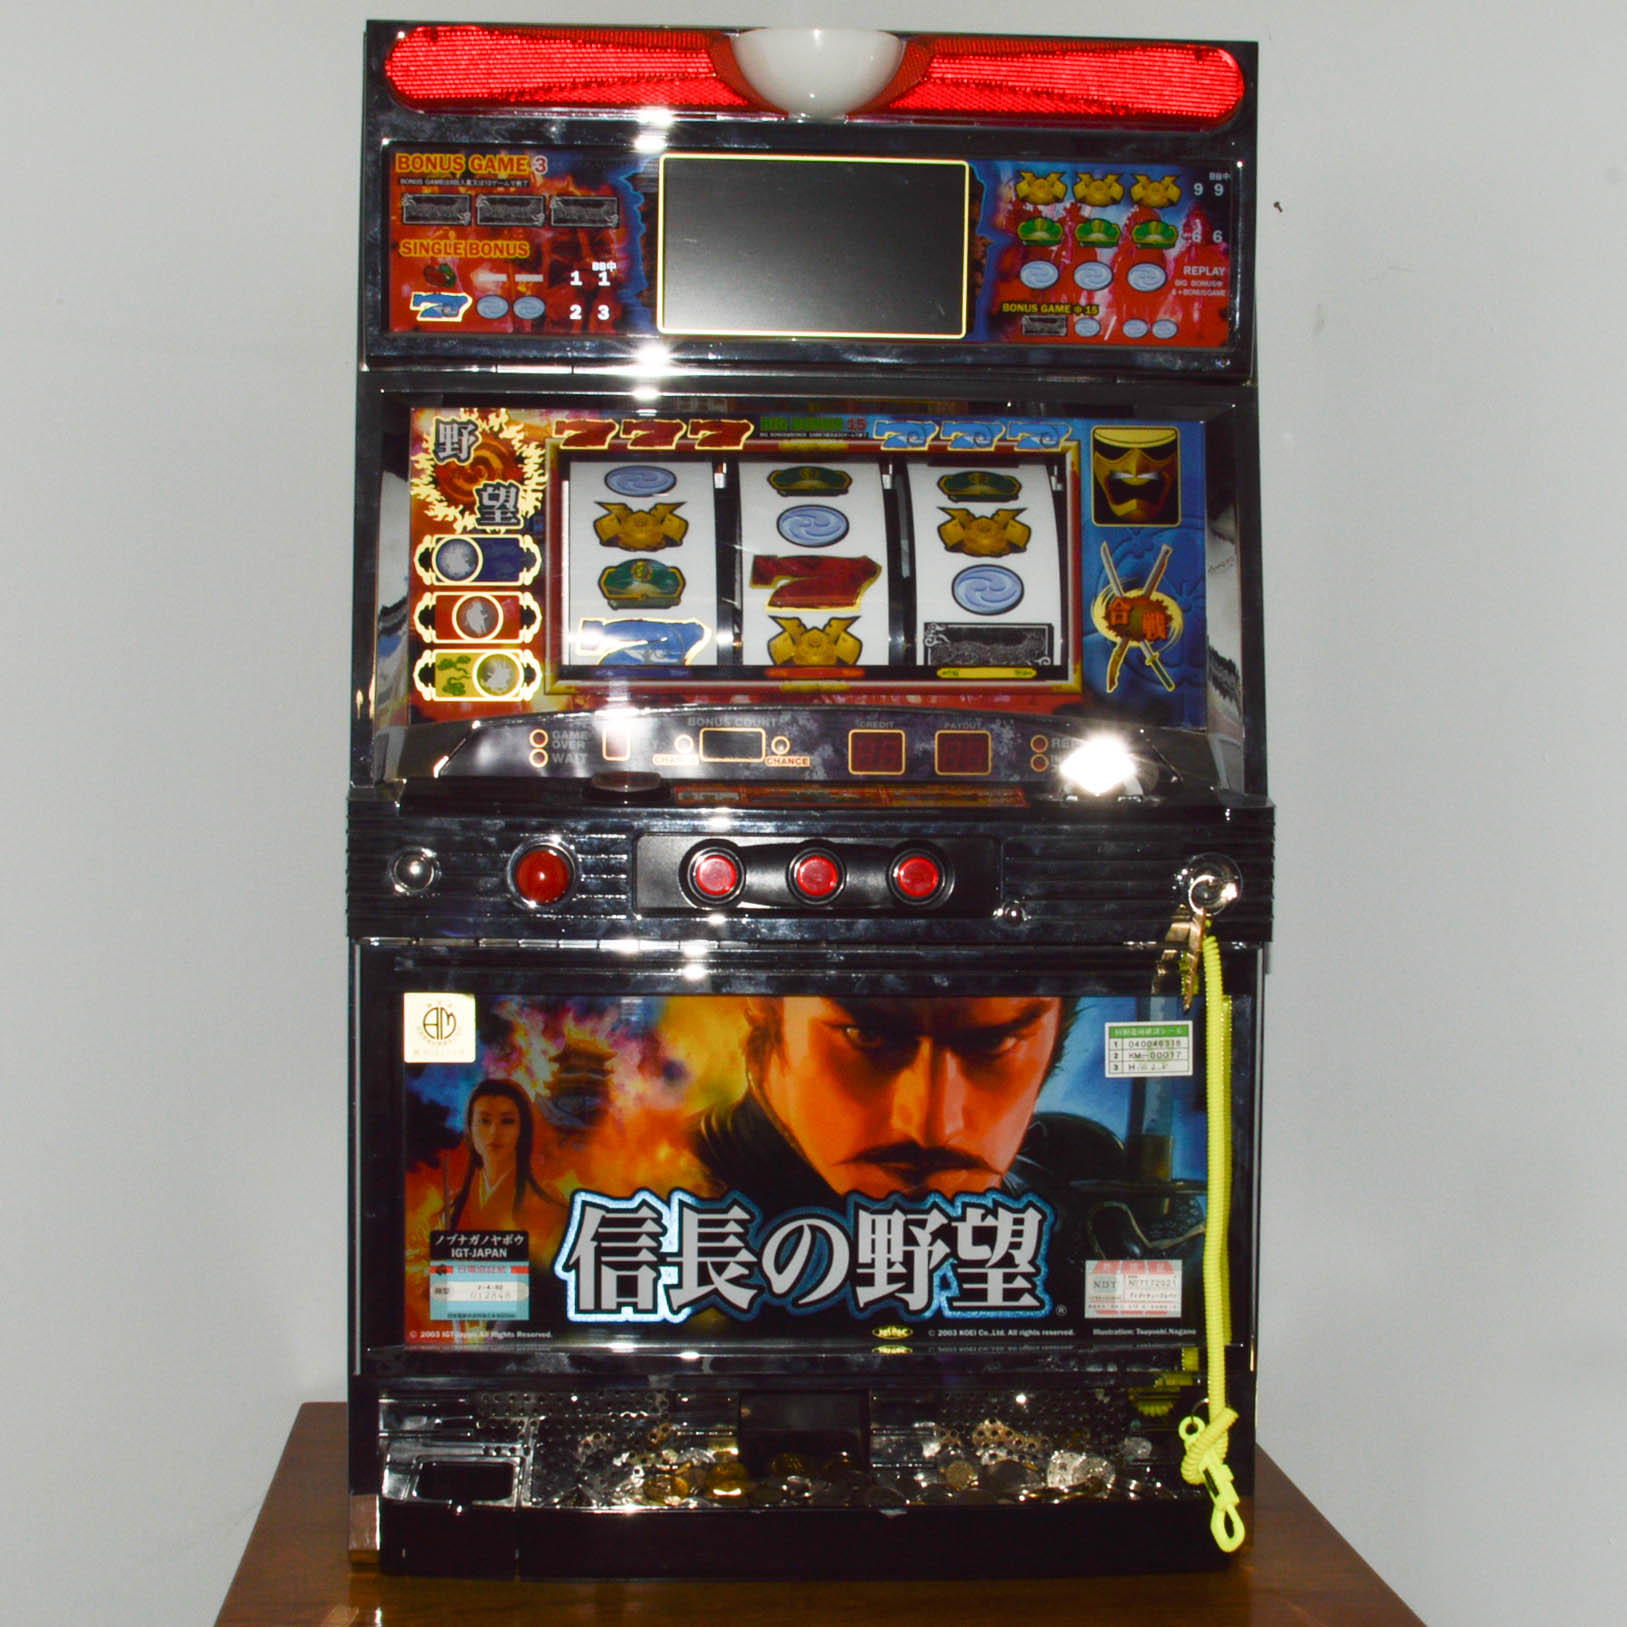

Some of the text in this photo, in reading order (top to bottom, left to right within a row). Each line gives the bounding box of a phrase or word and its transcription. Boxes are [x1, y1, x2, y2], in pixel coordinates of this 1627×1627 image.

[396, 153, 548, 175] BONUS GAME 3
[1193, 182, 1224, 197] 9 9
[1213, 230, 1223, 243] 6
[400, 241, 530, 258] SINGLE BONUS
[1183, 265, 1225, 276] REPLAY
[570, 270, 611, 286] 1 1
[570, 304, 610, 320] 2 3
[1002, 303, 1039, 313] BONUS
[1041, 304, 1071, 313] GAME
[1085, 305, 1099, 314] 15
[847, 418, 867, 431] 15
[435, 418, 479, 462] 野
[475, 484, 520, 527] 望
[688, 716, 732, 727] BONUS
[859, 720, 895, 729] CREDIT
[552, 730, 588, 740] GAME
[552, 740, 586, 749] OVER
[552, 753, 588, 764] WAIT
[766, 757, 809, 766] CHANCE
[435, 1233, 525, 1246] ノブナガノヤボウ
[451, 1247, 508, 1258] IGT-JAPAN
[565, 1200, 1046, 1313] 信長の野望
[420, 1330, 440, 1338] 2003
[938, 1328, 957, 1337] 2003
[959, 1328, 976, 1337] KOEI
[1007, 1328, 1018, 1337] All
[1019, 1328, 1040, 1338] rights
[1042, 1328, 1075, 1337] reserved.
